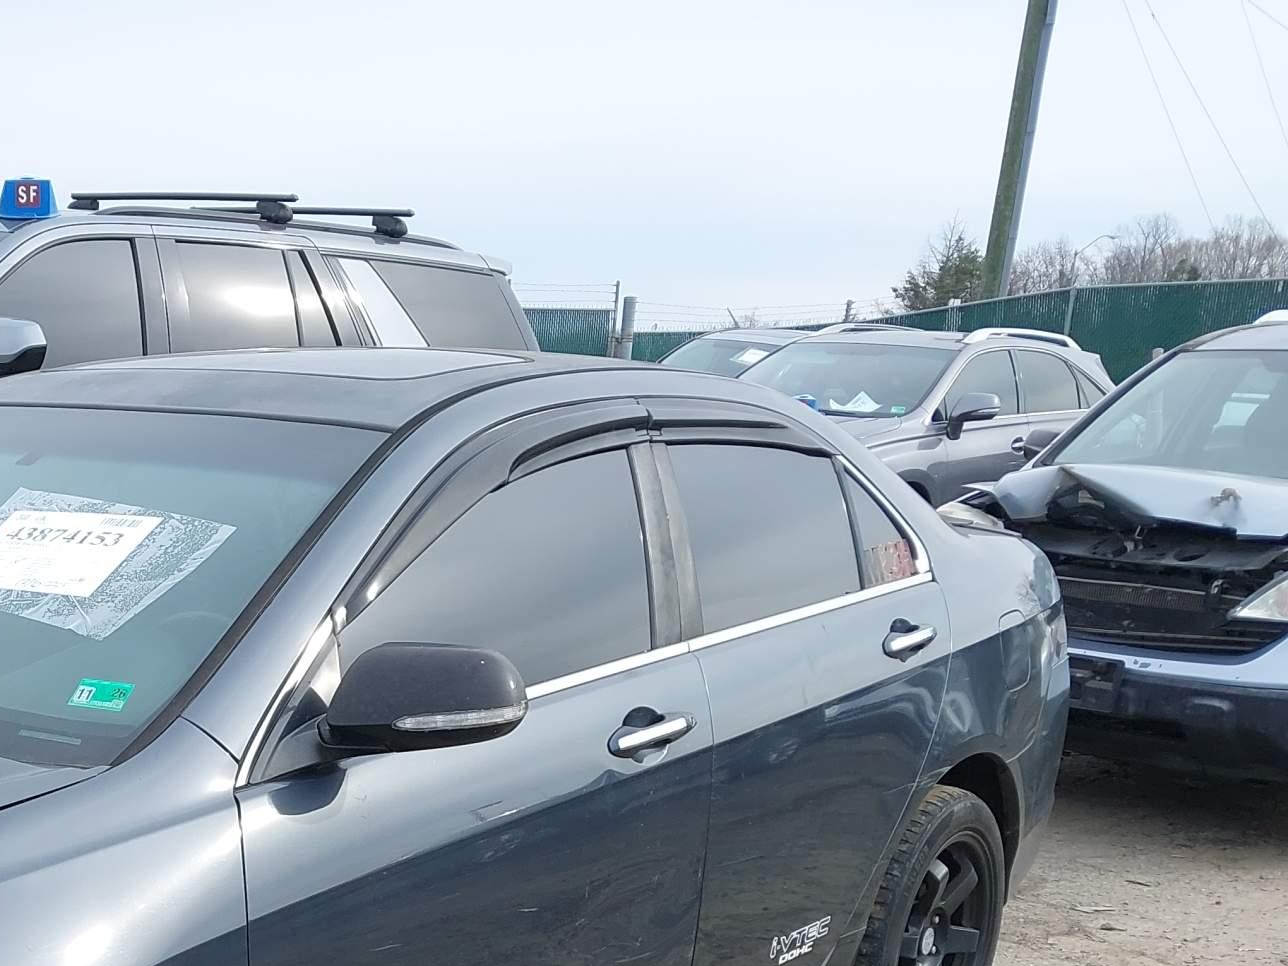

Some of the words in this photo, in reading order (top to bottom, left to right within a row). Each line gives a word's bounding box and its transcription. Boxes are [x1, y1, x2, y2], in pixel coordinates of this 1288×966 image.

[18, 185, 38, 203] SF
[6, 526, 125, 548] 43874153
[77, 687, 93, 700] 11
[778, 941, 814, 965] DOHC
